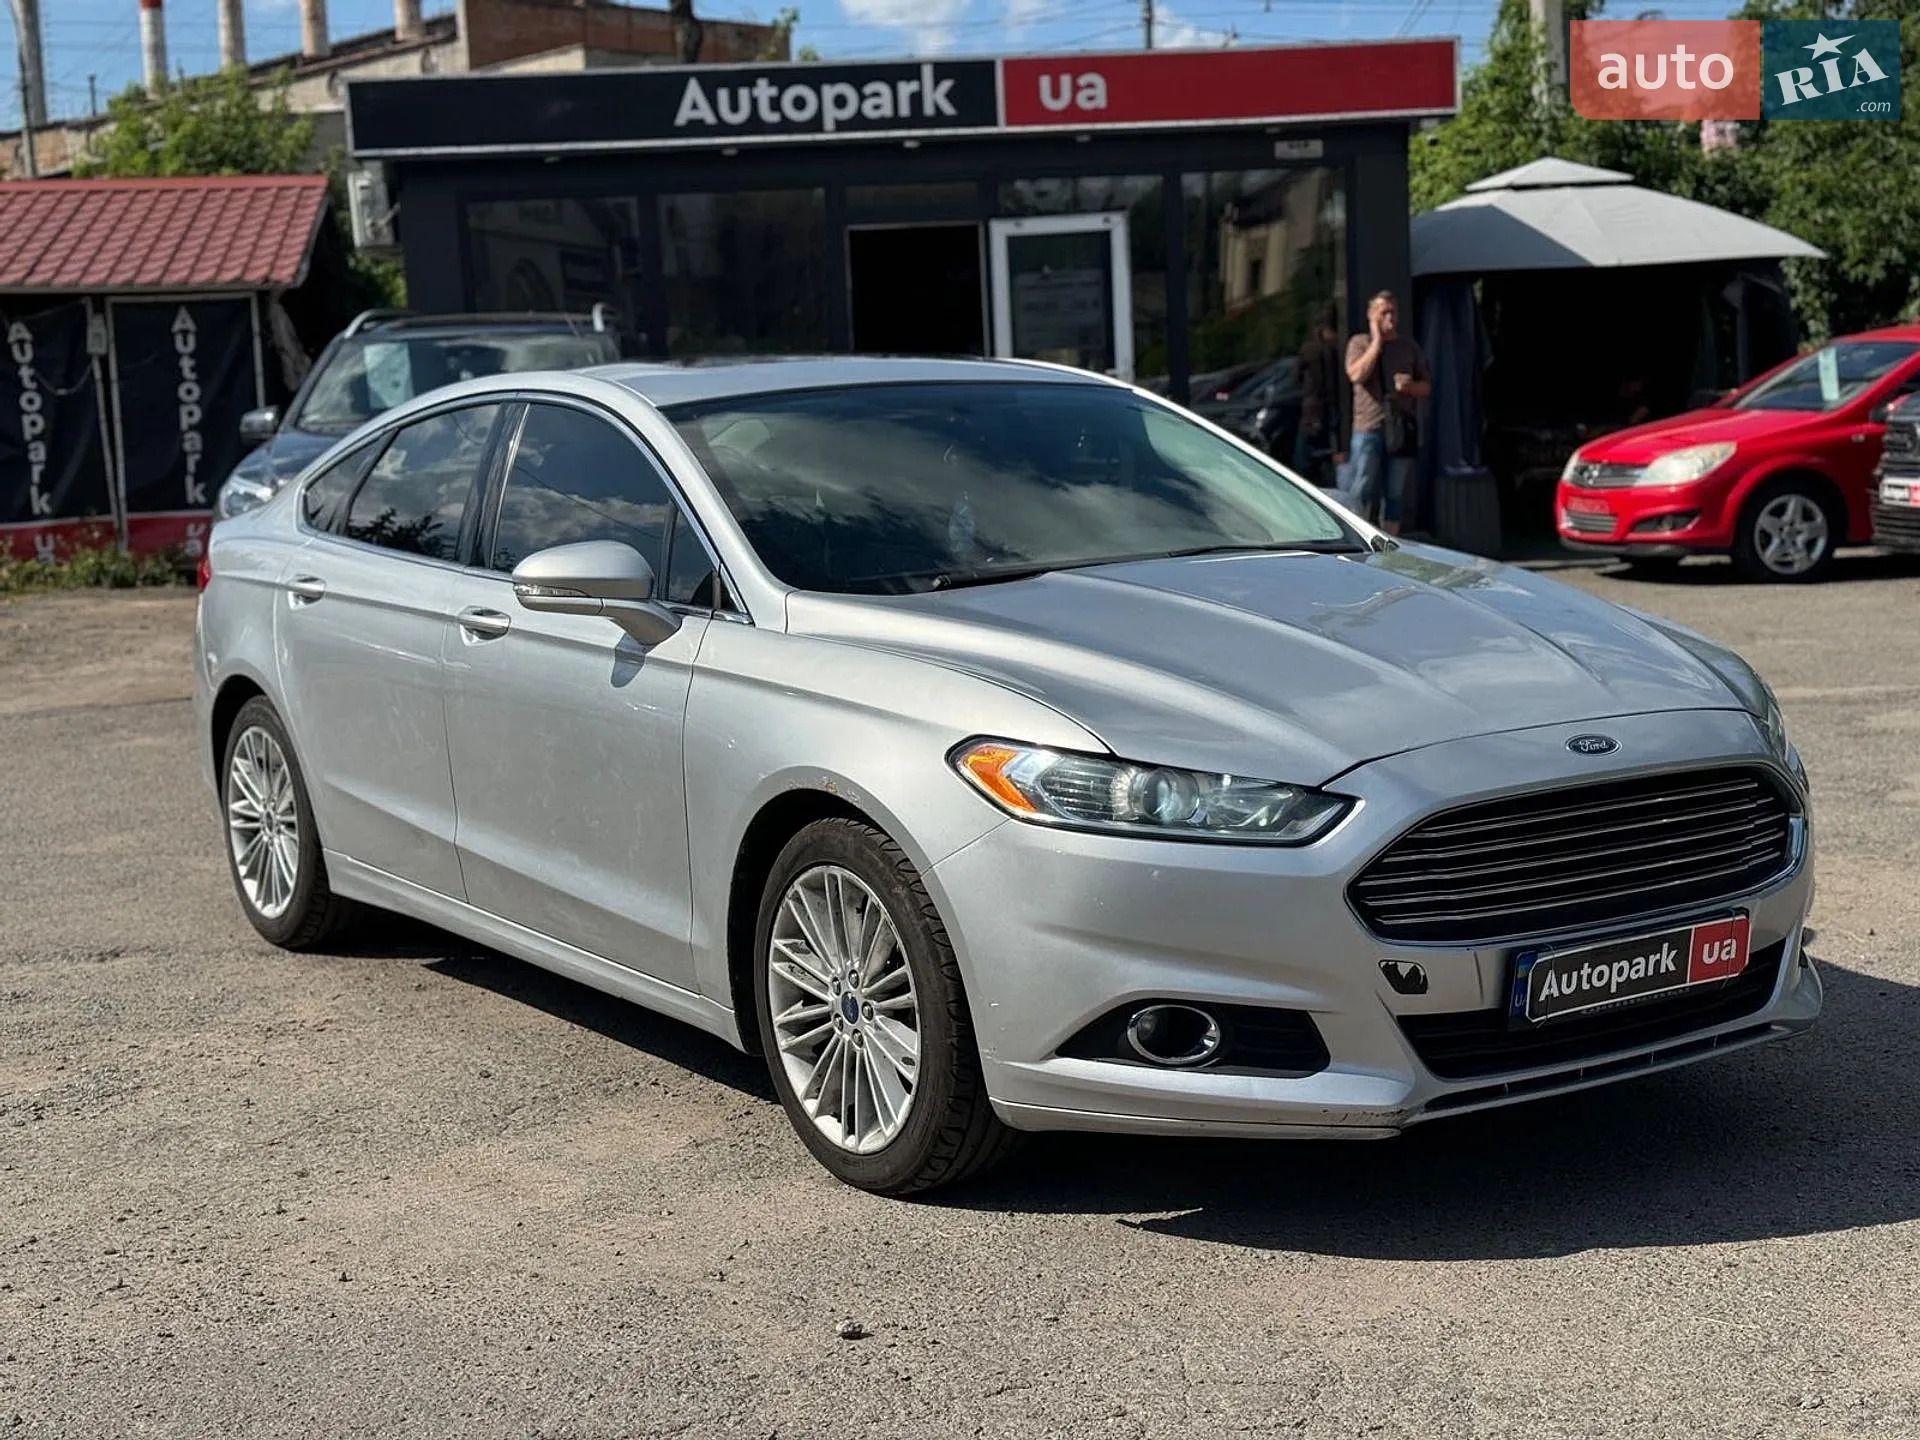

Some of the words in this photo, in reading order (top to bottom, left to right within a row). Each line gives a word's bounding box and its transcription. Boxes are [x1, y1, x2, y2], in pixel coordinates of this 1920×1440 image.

[673, 63, 958, 132] Autopark
[1038, 71, 1108, 112] ua
[7, 321, 52, 516] Autopark
[171, 305, 207, 505] Autopark
[1579, 739, 1608, 752] Ford
[1538, 942, 1678, 1002] Autopark
[1702, 937, 1737, 965] ua
